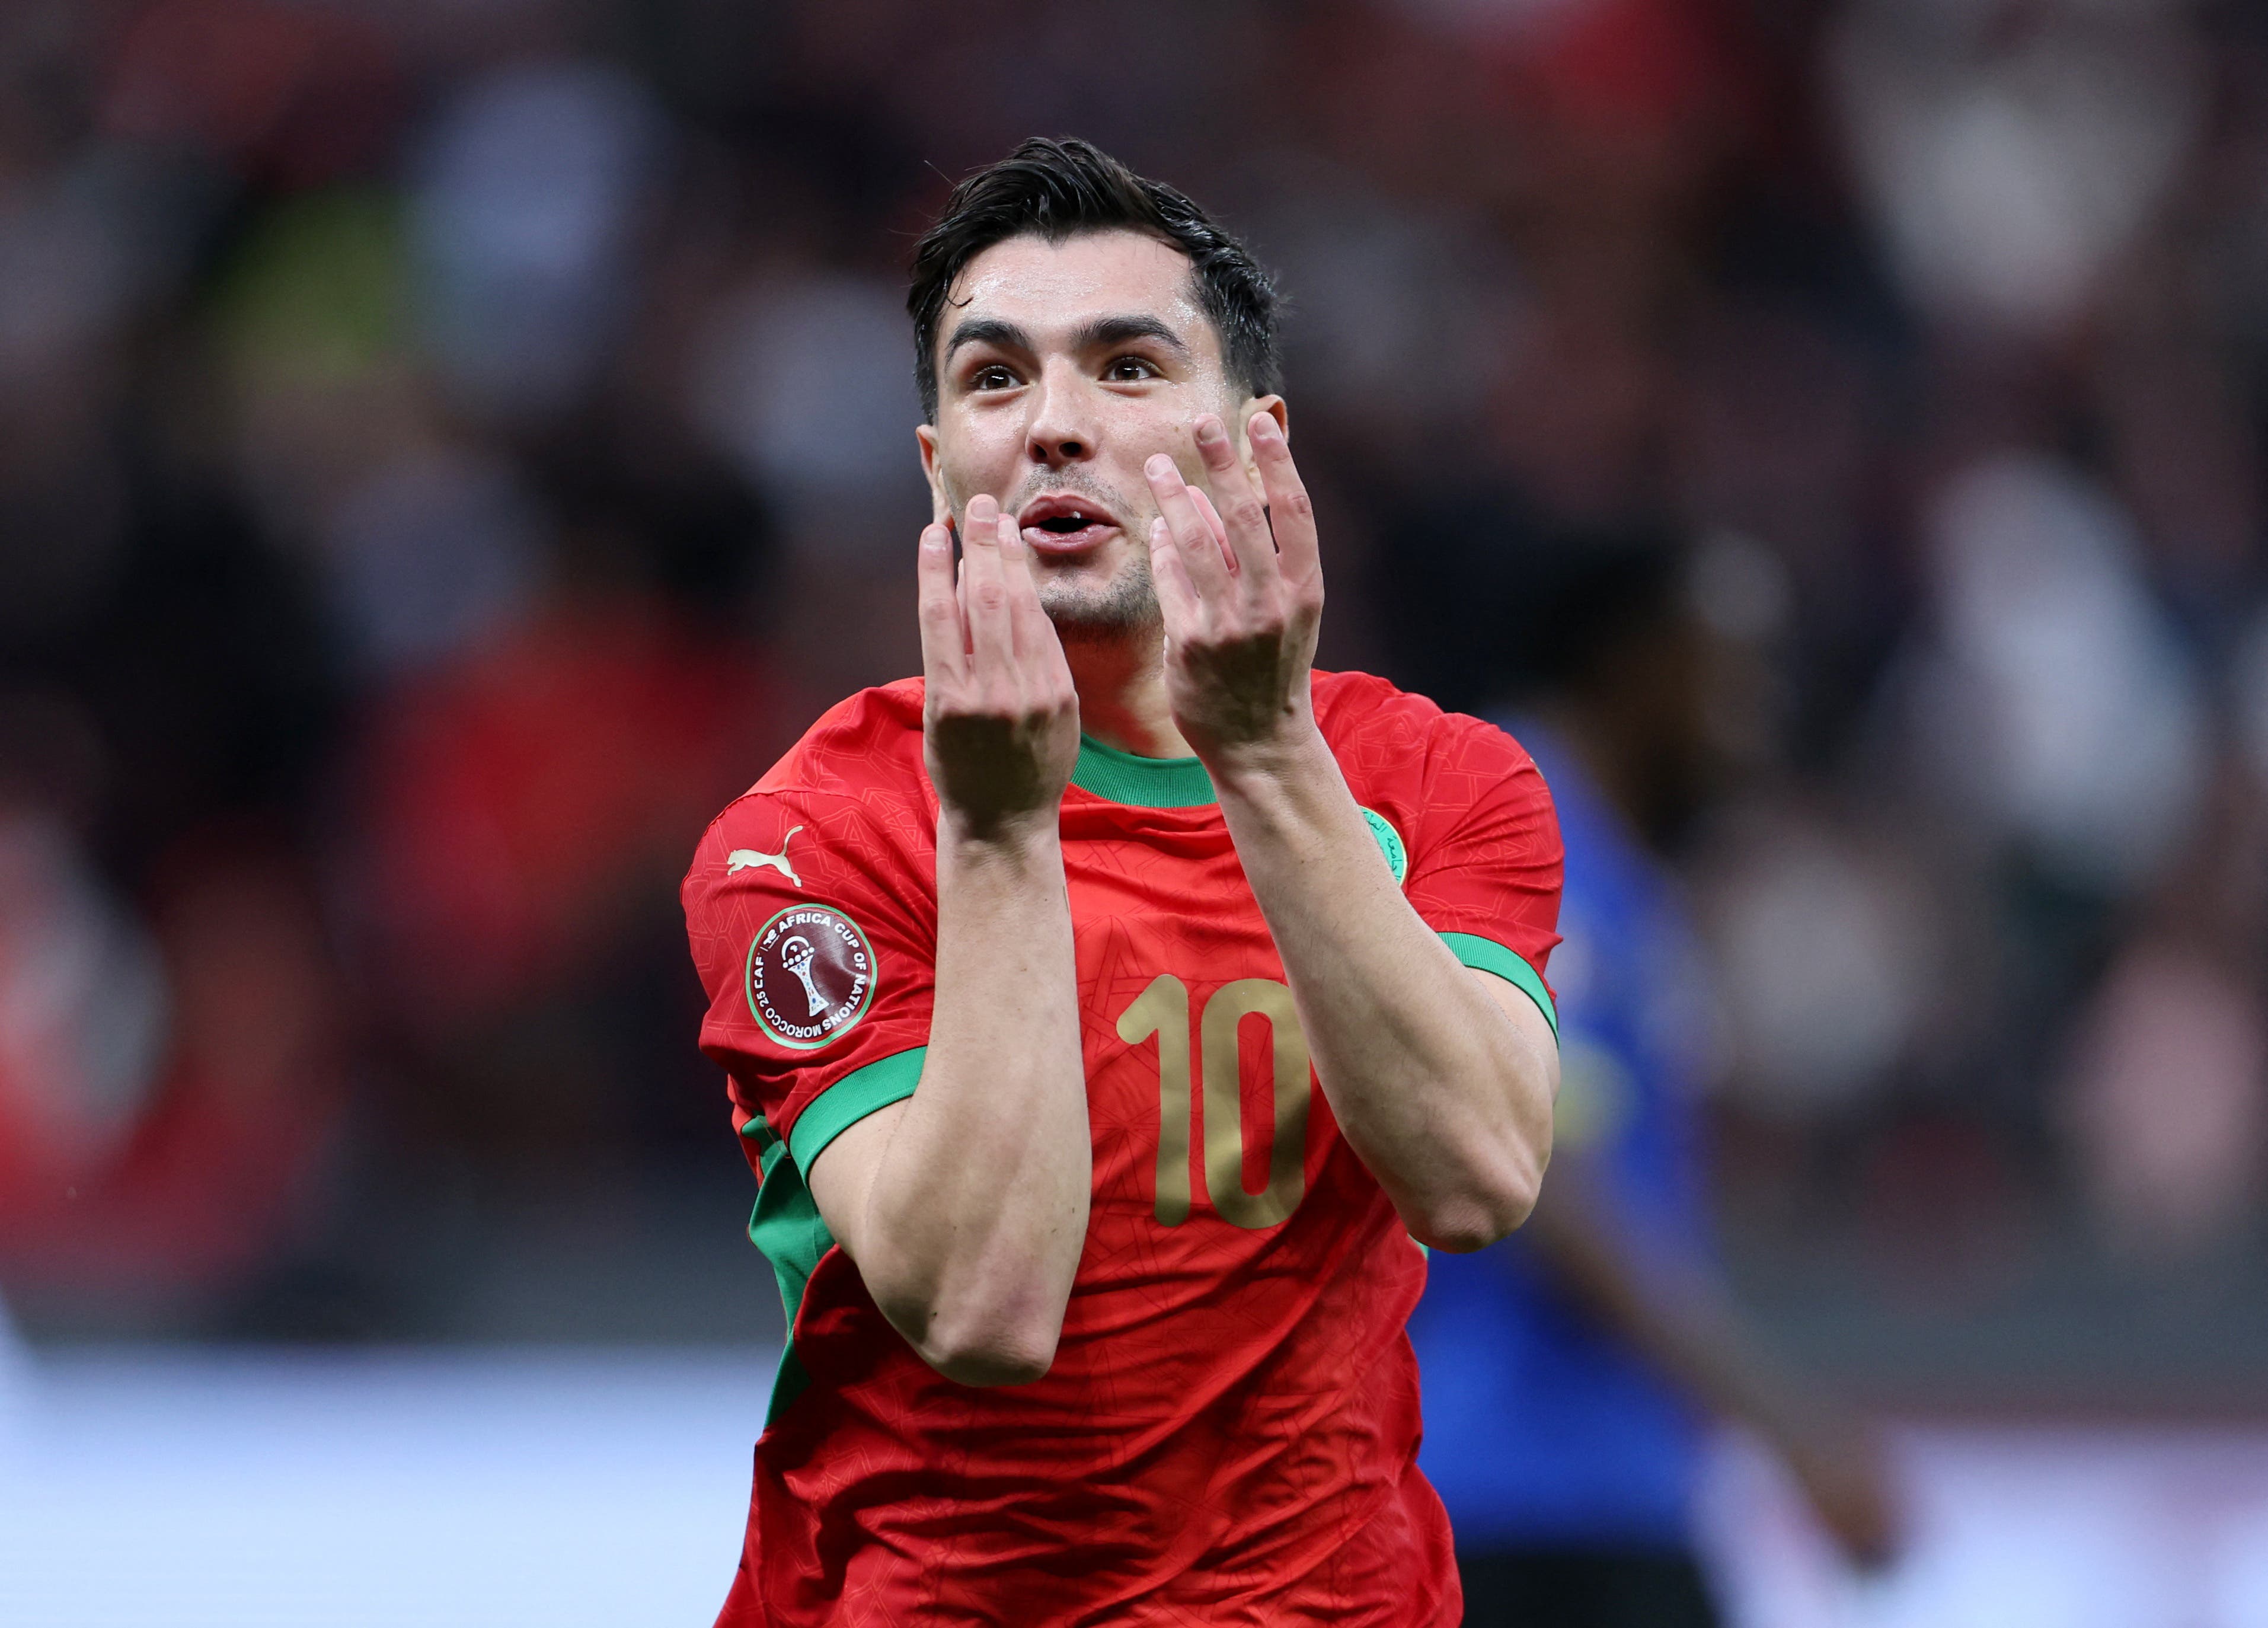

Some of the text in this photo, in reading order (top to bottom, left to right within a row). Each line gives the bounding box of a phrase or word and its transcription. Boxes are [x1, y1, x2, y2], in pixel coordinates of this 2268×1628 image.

[778, 912, 831, 933] AFRICA
[833, 922, 860, 949] CUP
[753, 956, 764, 989] CAF
[853, 952, 867, 971] OF
[756, 991, 769, 1007] 25
[822, 973, 867, 1031] NATIONS
[765, 1007, 823, 1038] MOROCCO
[1116, 973, 1311, 1229] 10
